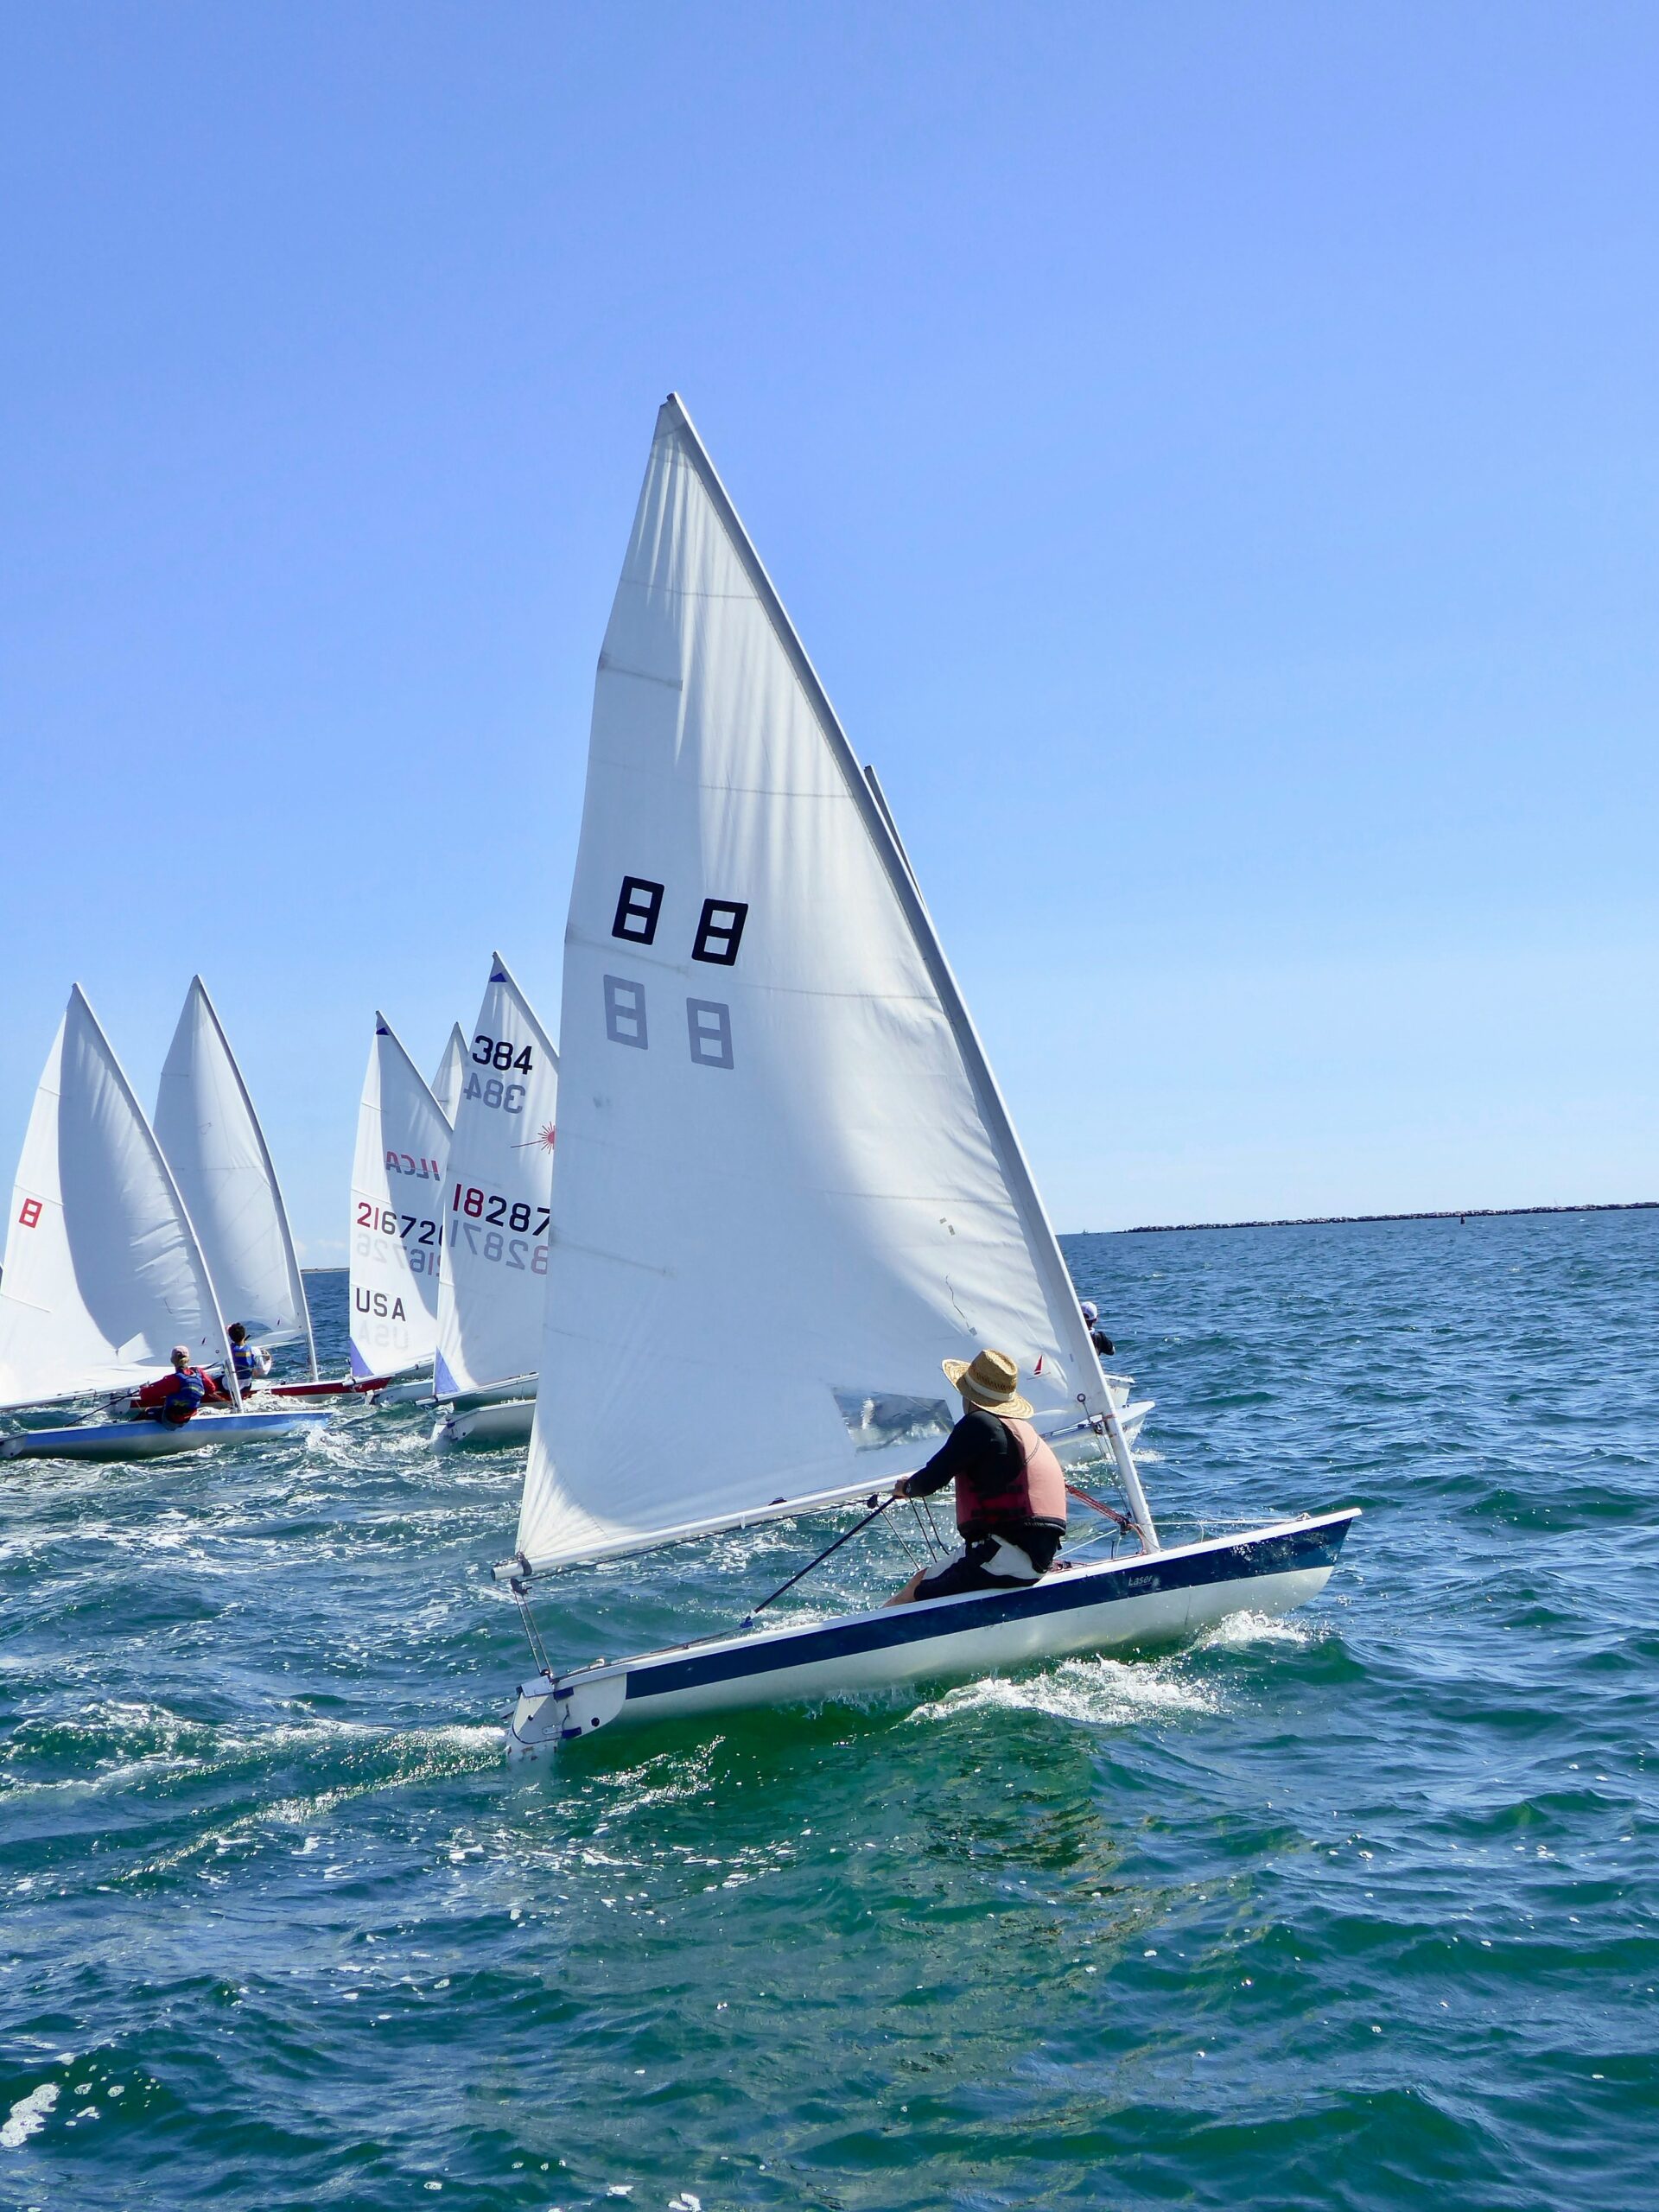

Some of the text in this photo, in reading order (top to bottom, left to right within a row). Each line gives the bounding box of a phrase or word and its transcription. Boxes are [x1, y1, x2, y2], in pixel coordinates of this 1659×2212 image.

[472, 1035, 533, 1075] 384
[18, 1198, 42, 1229] 8
[357, 1202, 443, 1247] 21672
[356, 1287, 406, 1322] USA
[1128, 1575, 1153, 1586] Laser
